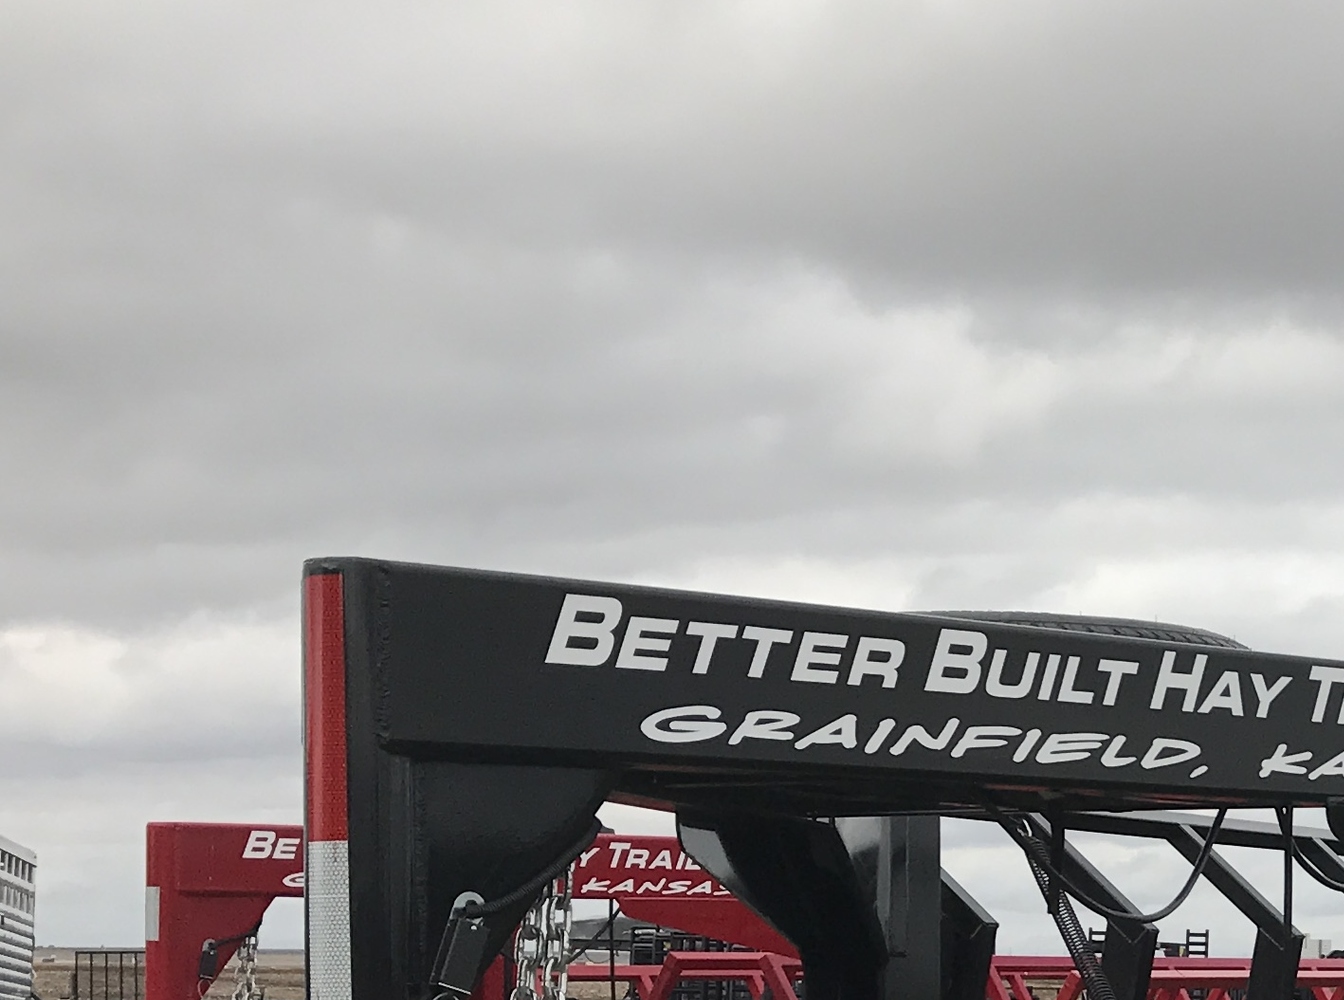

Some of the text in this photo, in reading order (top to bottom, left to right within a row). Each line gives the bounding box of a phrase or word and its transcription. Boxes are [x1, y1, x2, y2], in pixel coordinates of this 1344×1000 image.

[544, 593, 906, 690] BETTER
[923, 628, 1140, 707] BUILT
[1149, 650, 1293, 719] HAY
[640, 705, 1209, 779] GRAINFIELD,
[608, 841, 702, 871] TRAIL
